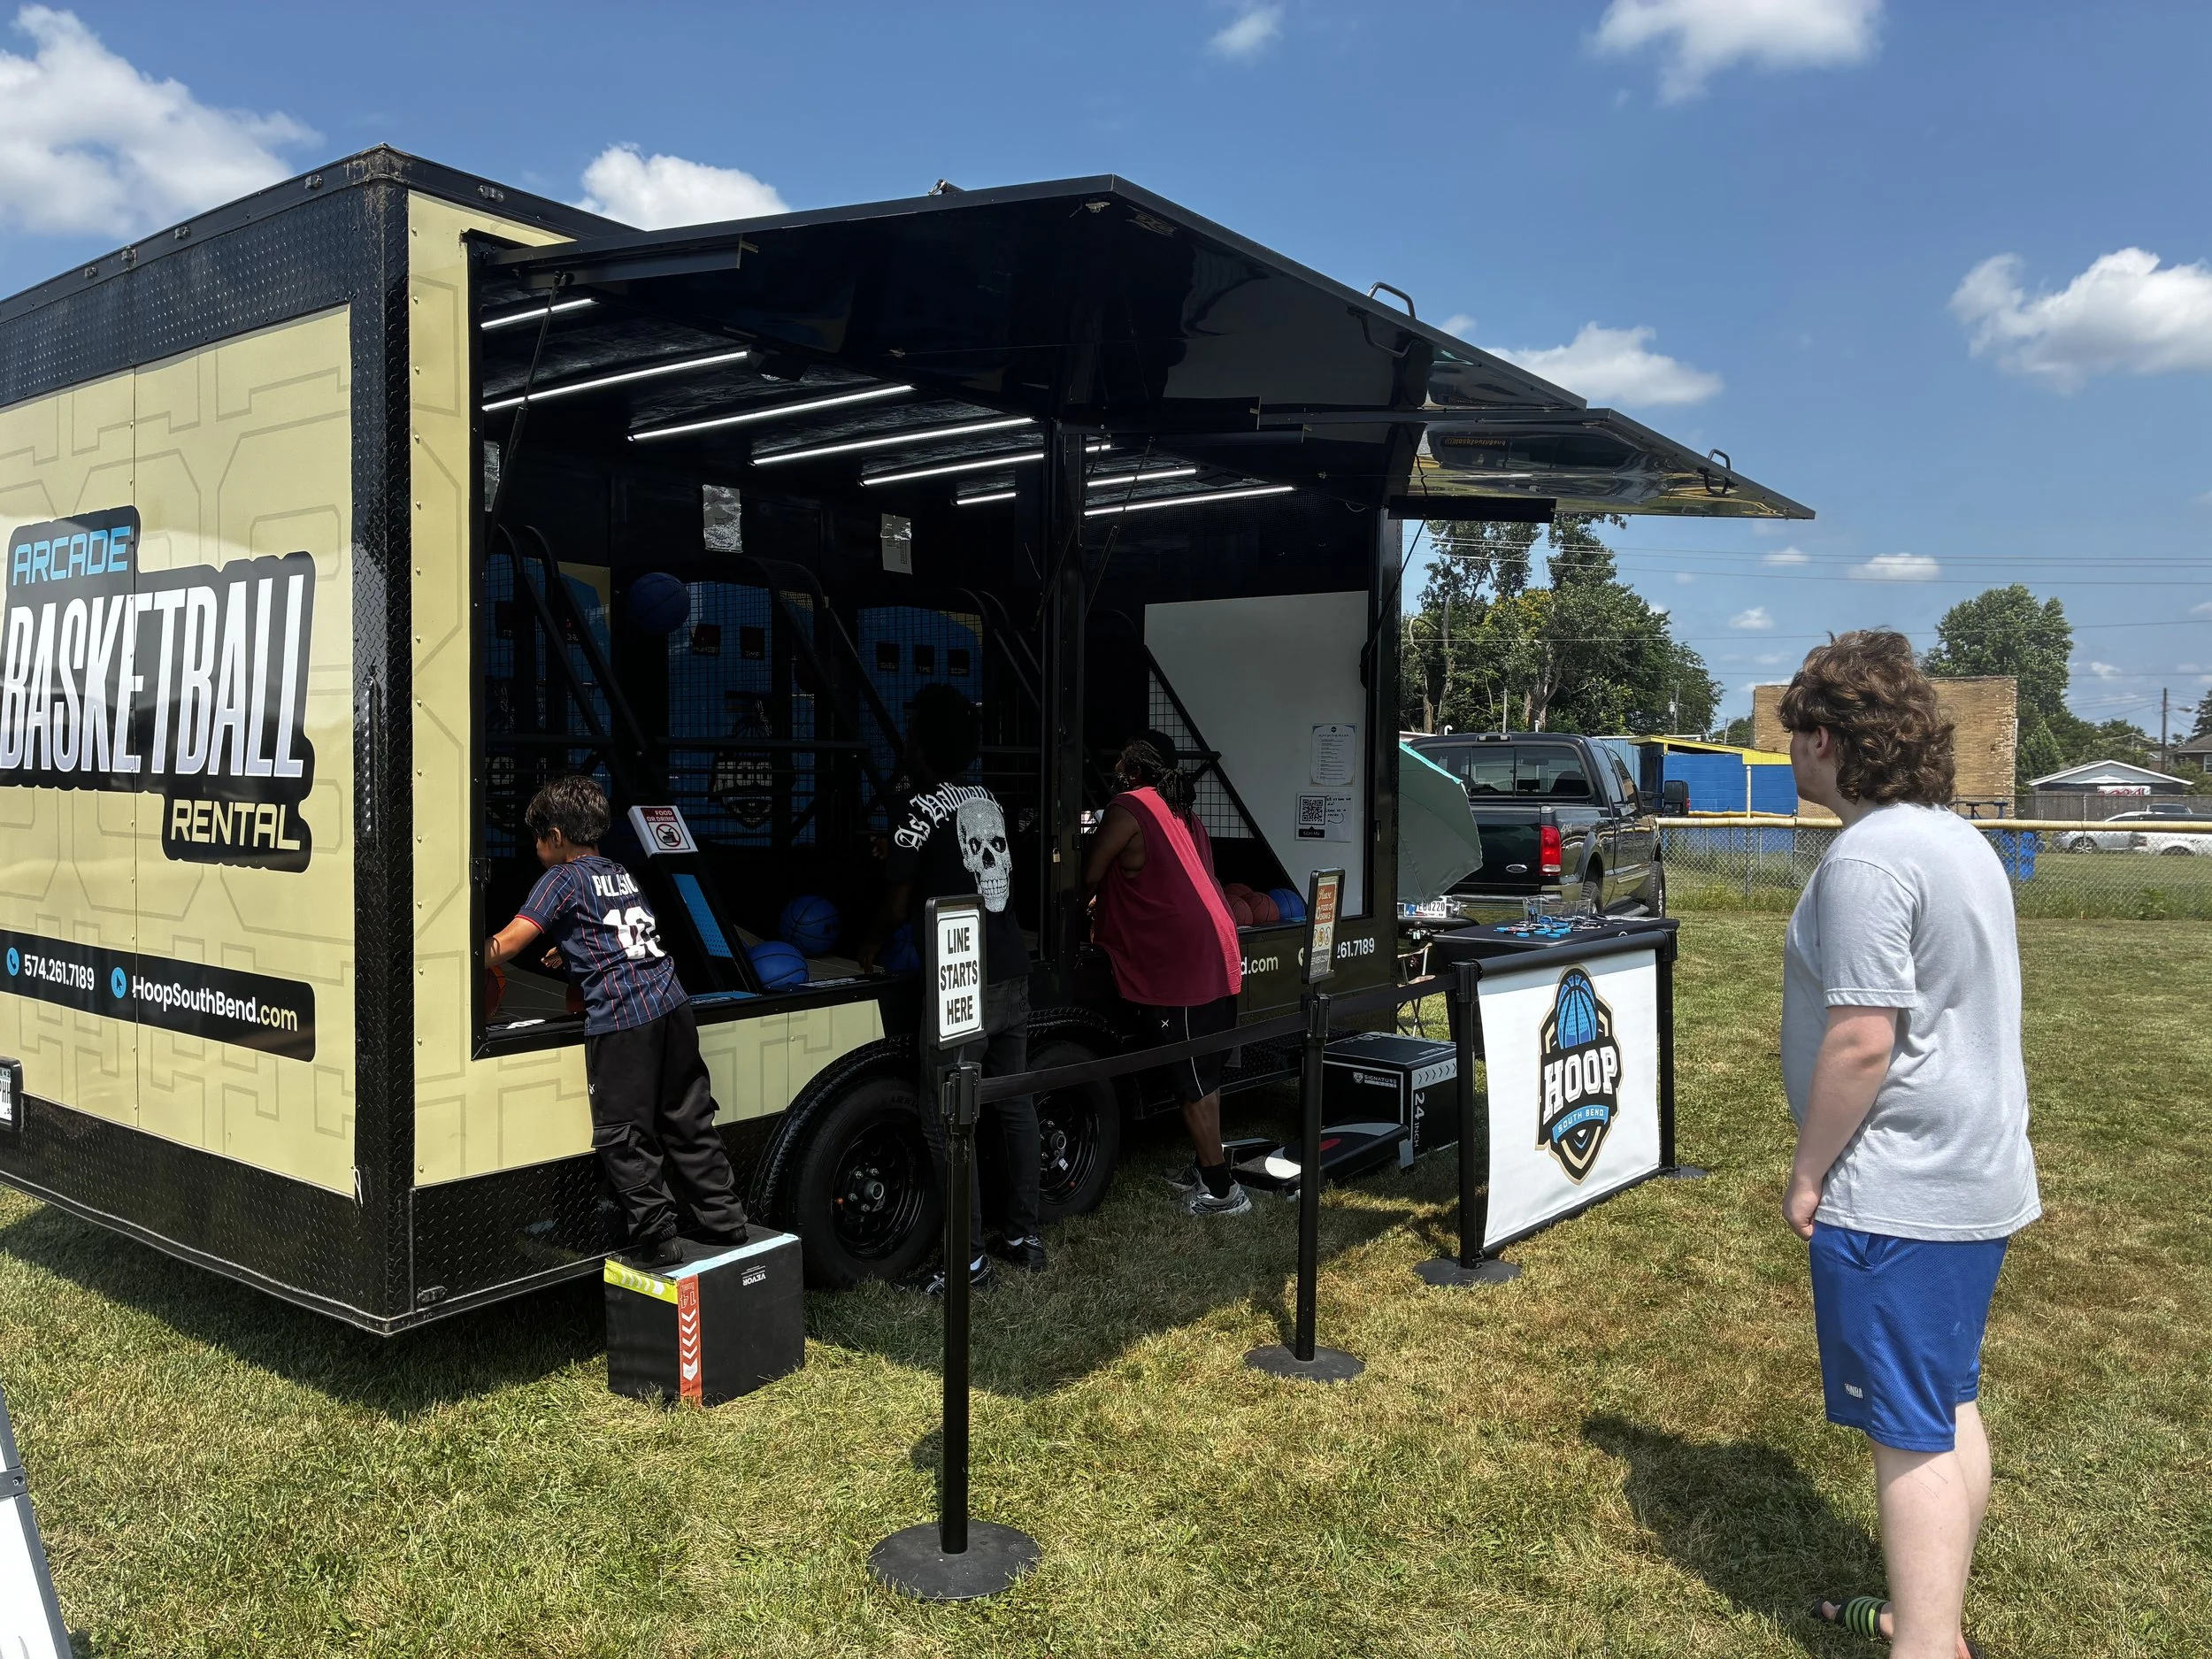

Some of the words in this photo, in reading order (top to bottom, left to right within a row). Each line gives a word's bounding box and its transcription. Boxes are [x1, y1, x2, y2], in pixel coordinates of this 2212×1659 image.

[12, 526, 131, 586] ARCADE
[0, 573, 304, 779] BASKETBALL
[171, 798, 301, 850] RENTAL
[948, 927, 970, 955] LINE
[24, 954, 95, 991] 574.261.7189
[940, 960, 978, 991] STARTS
[132, 975, 298, 1032] HoopSouthBend.com
[947, 995, 973, 1025] HERE
[1543, 1045, 1618, 1125] HOOP
[1414, 1092, 1425, 1120] 24
[1557, 1112, 1583, 1133] SOUTH
[1585, 1108, 1604, 1118] BEND
[742, 1272, 766, 1286] VEVOR
[680, 1291, 696, 1309] 14
